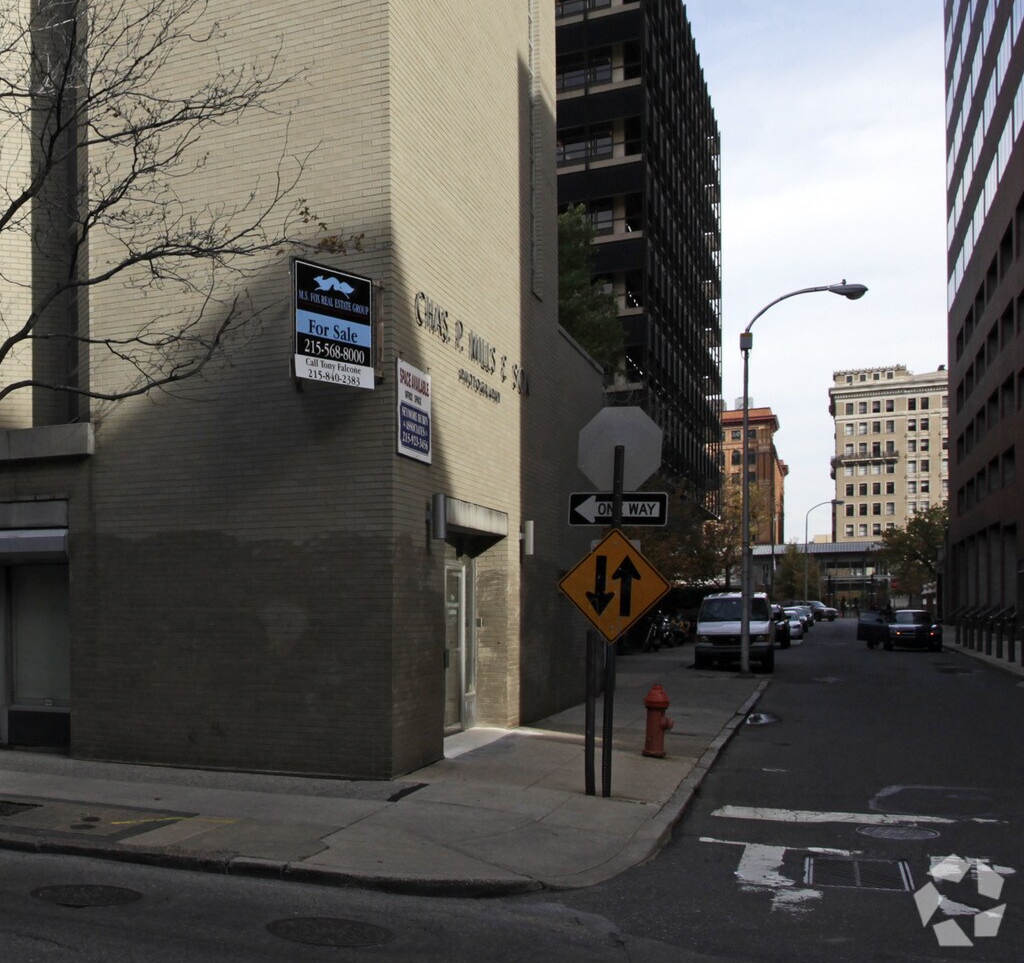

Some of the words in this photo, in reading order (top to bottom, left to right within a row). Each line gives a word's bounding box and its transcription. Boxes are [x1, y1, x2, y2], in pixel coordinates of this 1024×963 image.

[298, 290, 309, 302] M.S.
[310, 292, 320, 303] FOX
[321, 295, 333, 307] REAL
[334, 298, 351, 311] ESTATE
[352, 302, 369, 315] GROUP
[308, 318, 330, 337] For
[333, 324, 358, 343] Sale
[304, 338, 365, 364] 215-568-8000
[305, 358, 319, 368] Call
[320, 360, 336, 373] Tony
[337, 363, 362, 375] Falcone
[308, 369, 361, 386] 215-840-2383
[400, 367, 411, 388] SPACE
[412, 374, 430, 397] AVAILABLE
[598, 503, 623, 515] ON
[629, 503, 656, 515] WAY
